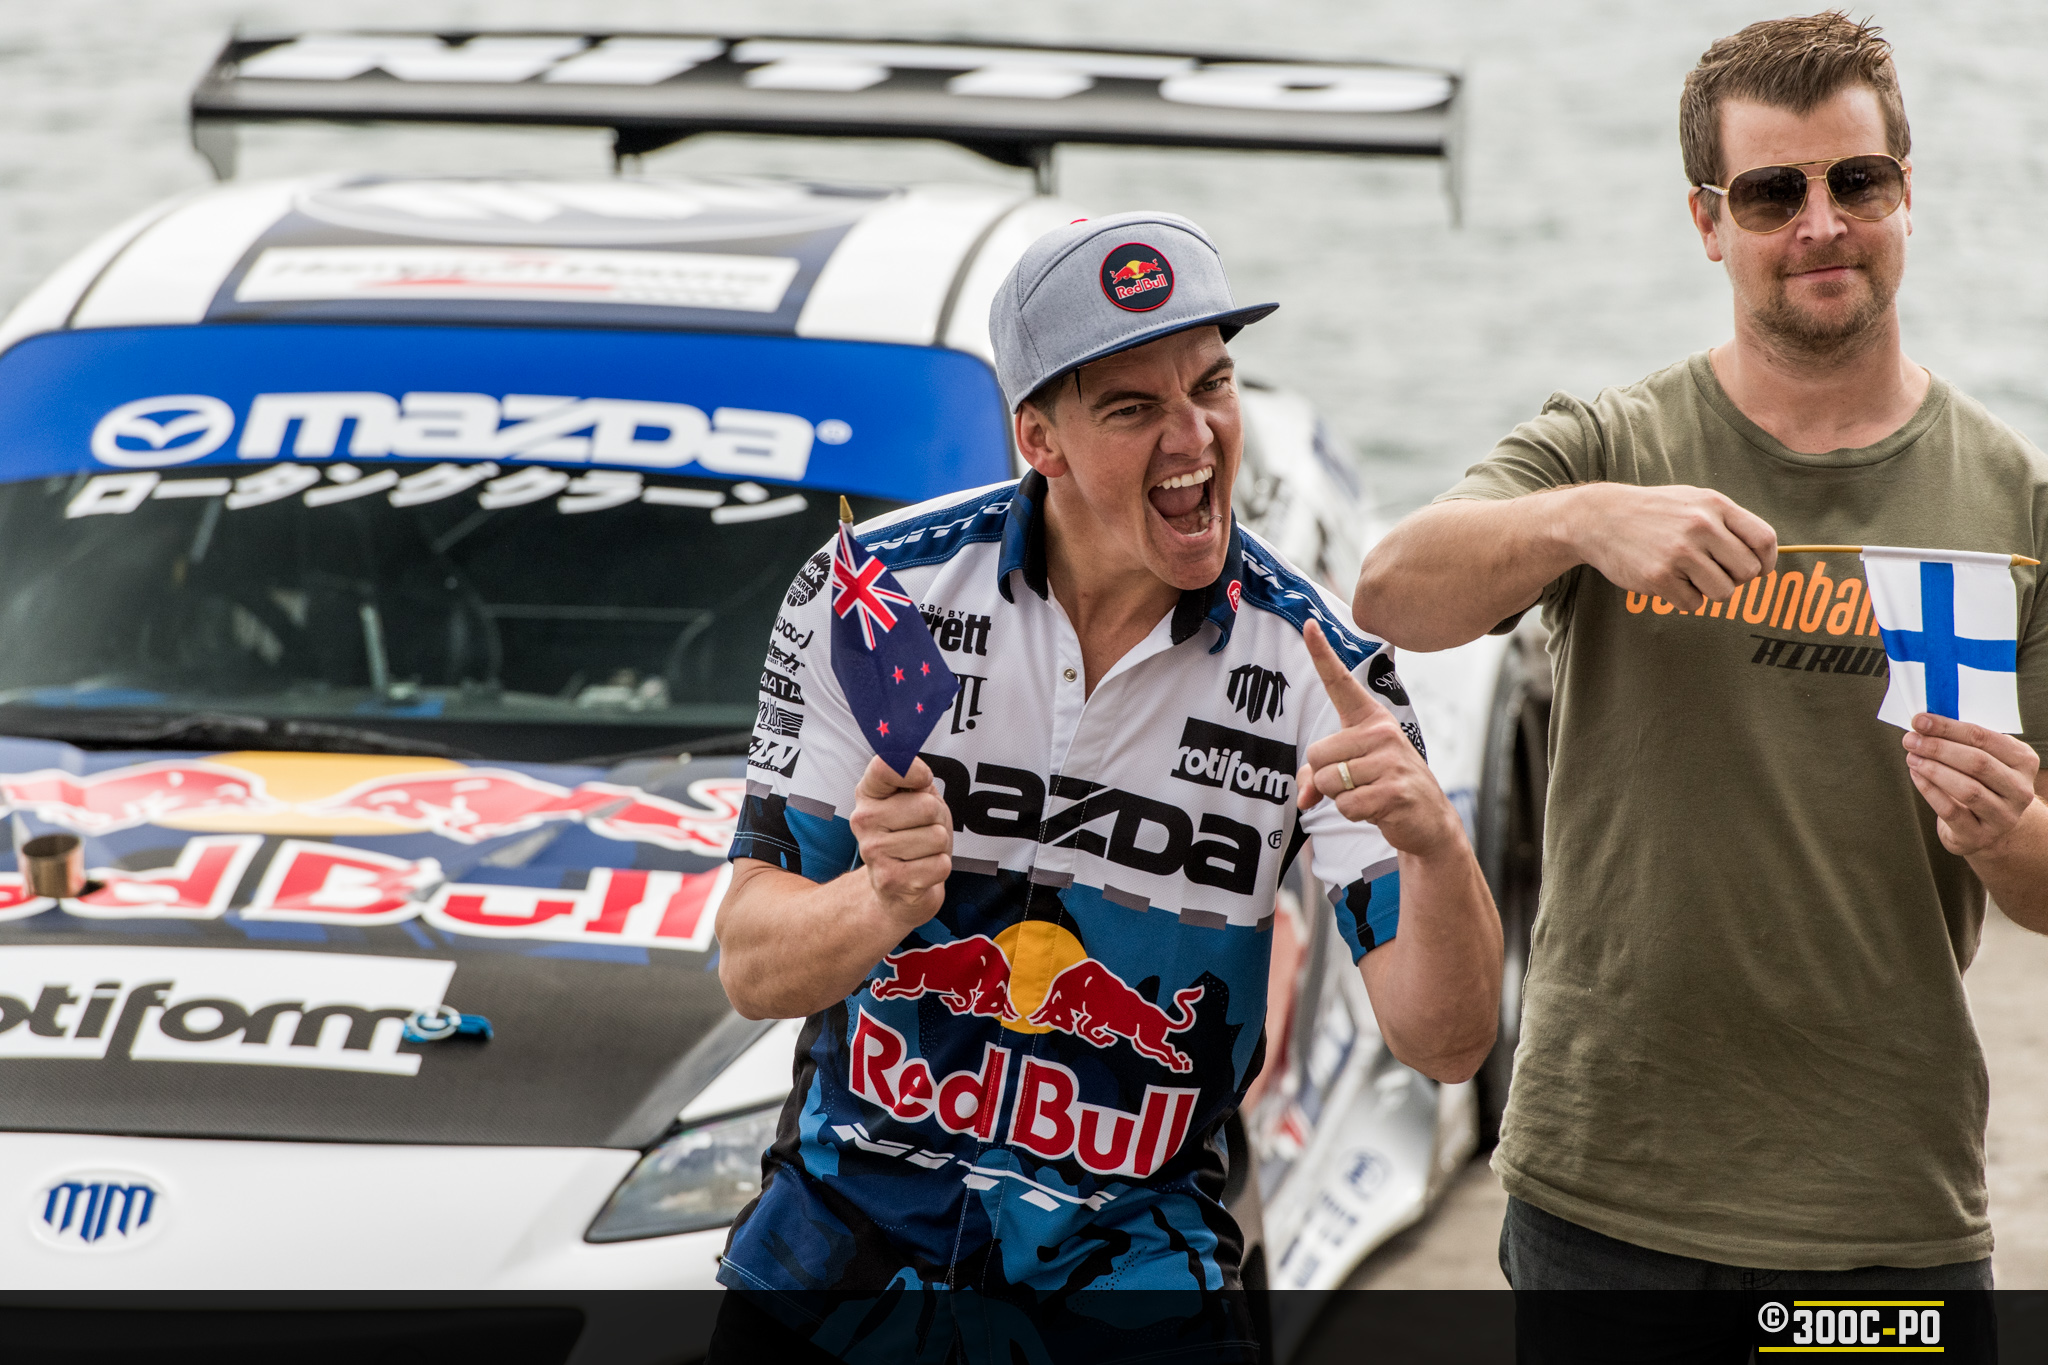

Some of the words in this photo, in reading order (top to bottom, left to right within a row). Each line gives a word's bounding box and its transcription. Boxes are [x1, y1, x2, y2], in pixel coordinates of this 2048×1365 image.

[225, 34, 1458, 113] NITTO
[1115, 279, 1144, 299] Red
[1140, 274, 1168, 291] Bull
[948, 610, 965, 618] BY
[1179, 745, 1297, 801] rotiform
[849, 1004, 1012, 1144] Red
[1006, 1055, 1201, 1180] Bull
